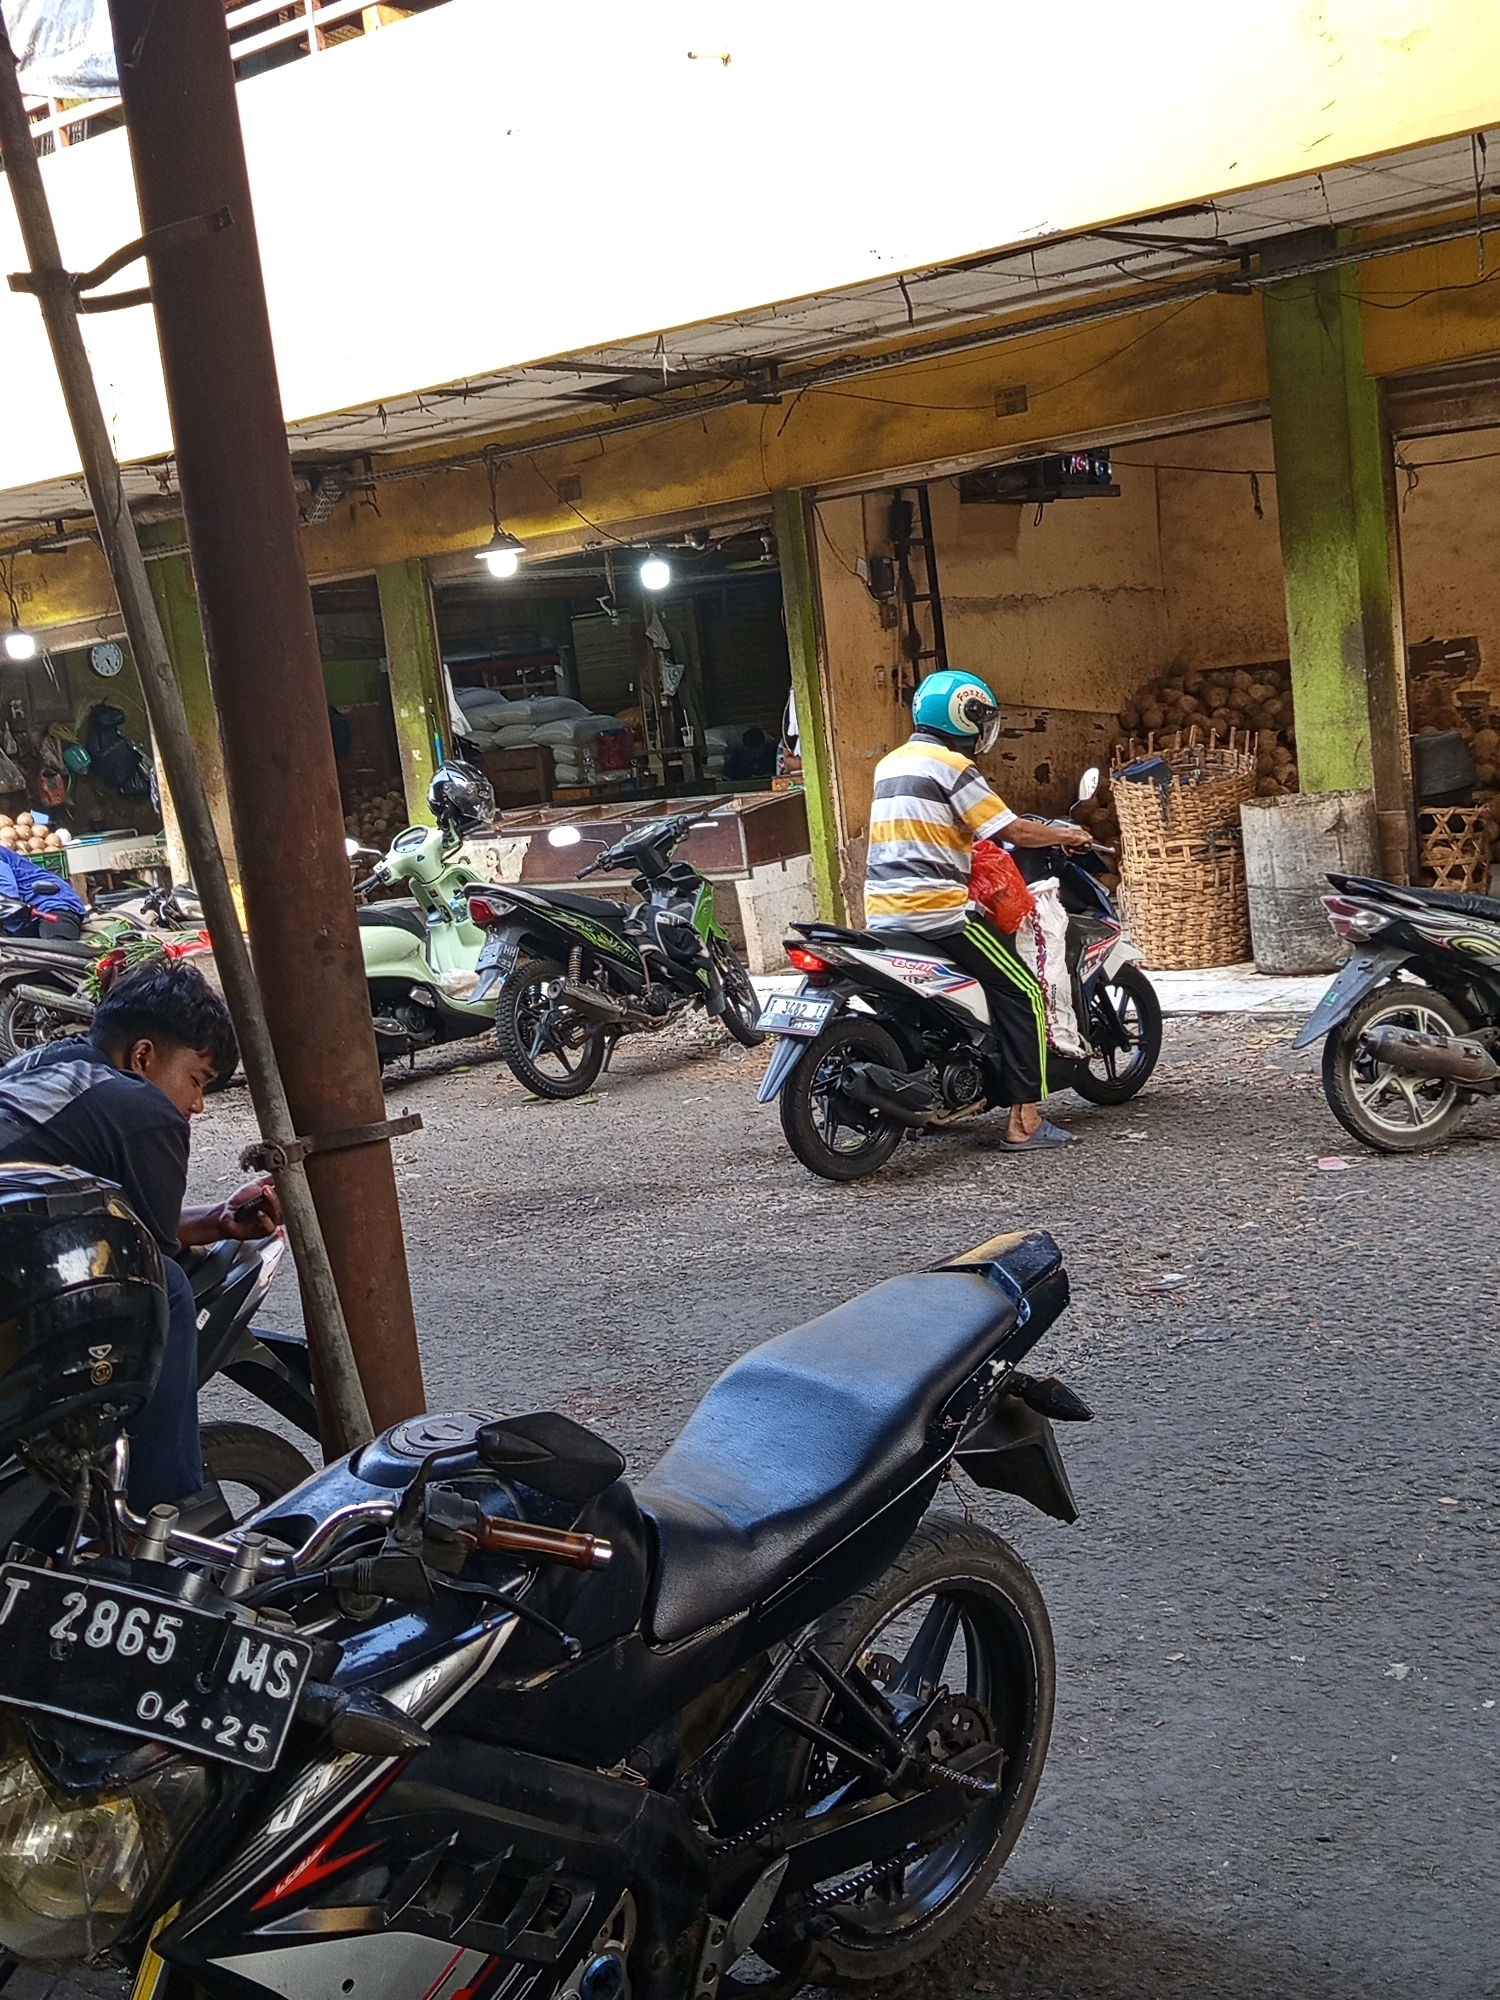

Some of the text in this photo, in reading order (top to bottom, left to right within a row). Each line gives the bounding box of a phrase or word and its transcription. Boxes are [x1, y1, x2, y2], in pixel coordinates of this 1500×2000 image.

[0, 1577, 298, 1699] T 2865 MS
